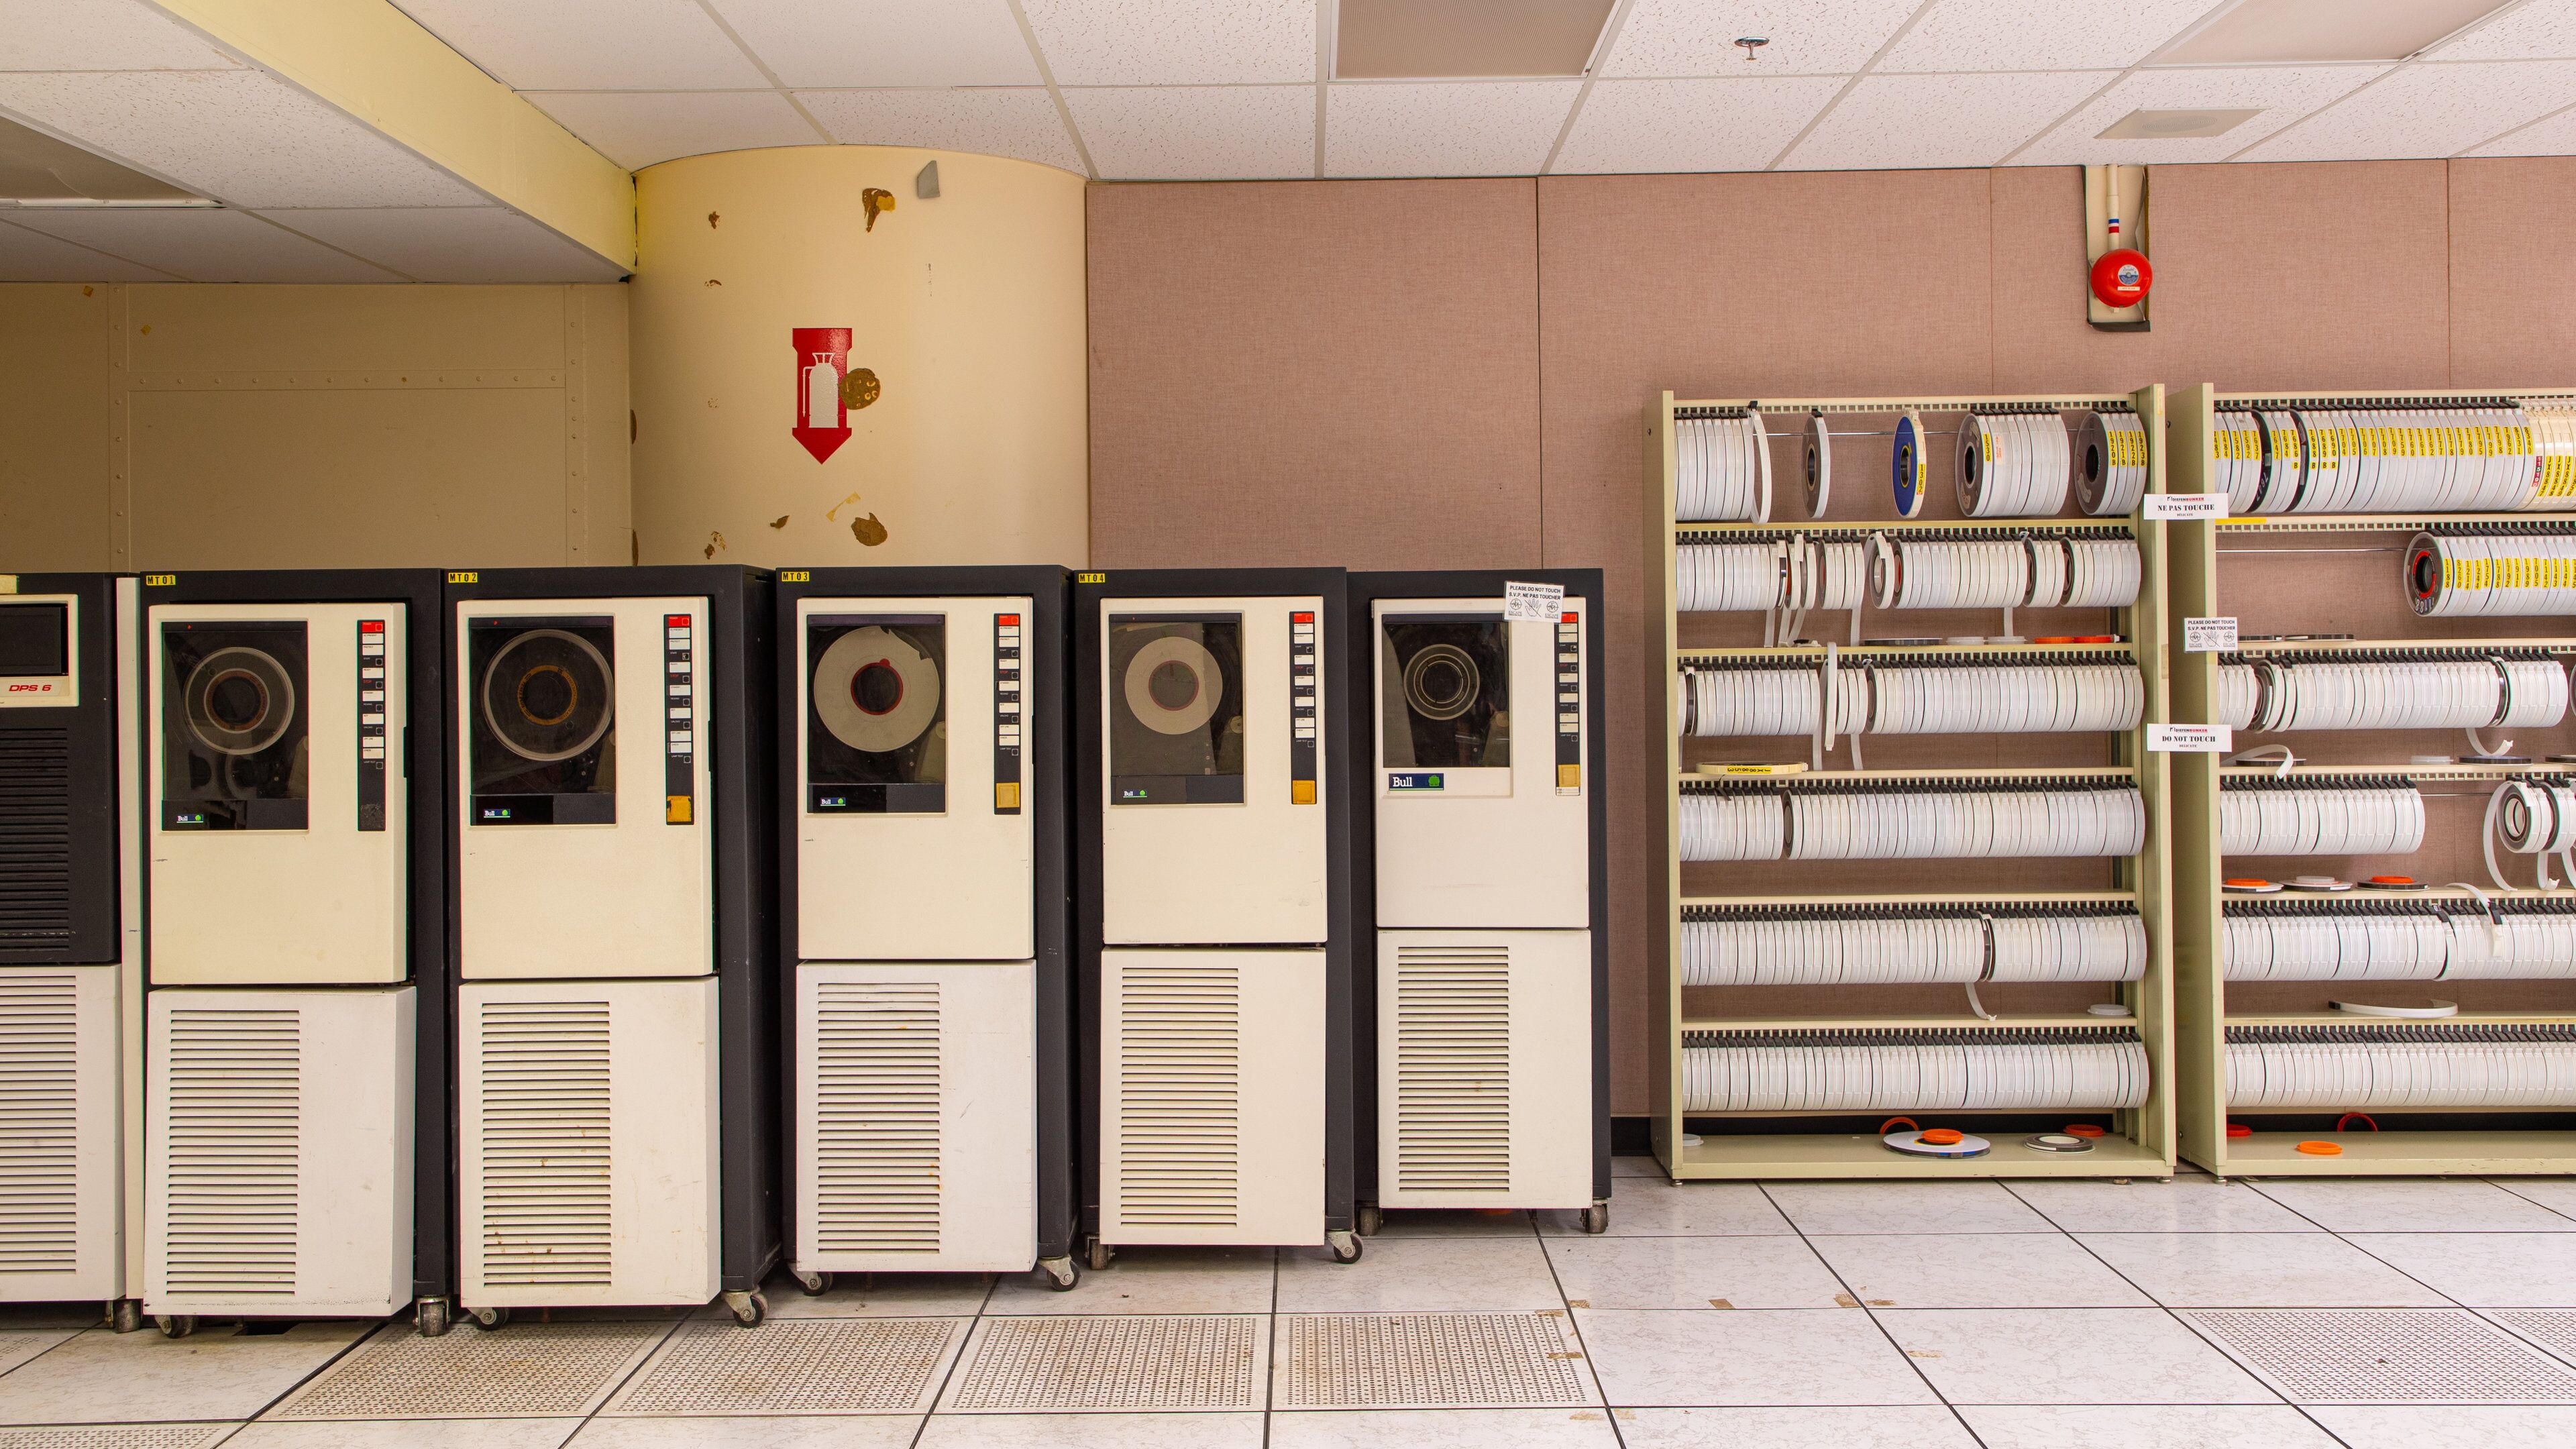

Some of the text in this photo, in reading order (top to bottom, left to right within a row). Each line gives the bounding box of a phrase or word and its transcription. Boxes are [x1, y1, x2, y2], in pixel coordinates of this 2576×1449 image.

[2290, 429, 2298, 458] 7686
[2308, 429, 2316, 458] 7688
[2328, 429, 2337, 456] 7690
[2359, 428, 2367, 455] 7706
[2379, 428, 2387, 455] 7708
[2388, 427, 2397, 455] 7709
[2407, 428, 2415, 456] 7760
[2426, 428, 2434, 455] 7762
[2435, 427, 2443, 455] 7777
[2445, 427, 2454, 456] 7778
[2455, 427, 2464, 455] 7779
[2465, 427, 2473, 455] 7780
[2474, 427, 2483, 455] 7795
[2493, 426, 2503, 454] 7798
[2504, 427, 2512, 455] 7962
[2524, 427, 2532, 454] 8340
[147, 576, 174, 584] MT01
[449, 573, 476, 582] MT02
[782, 572, 808, 581] MT03
[1079, 574, 1104, 582] MT04
[1392, 777, 1413, 787] Bull
